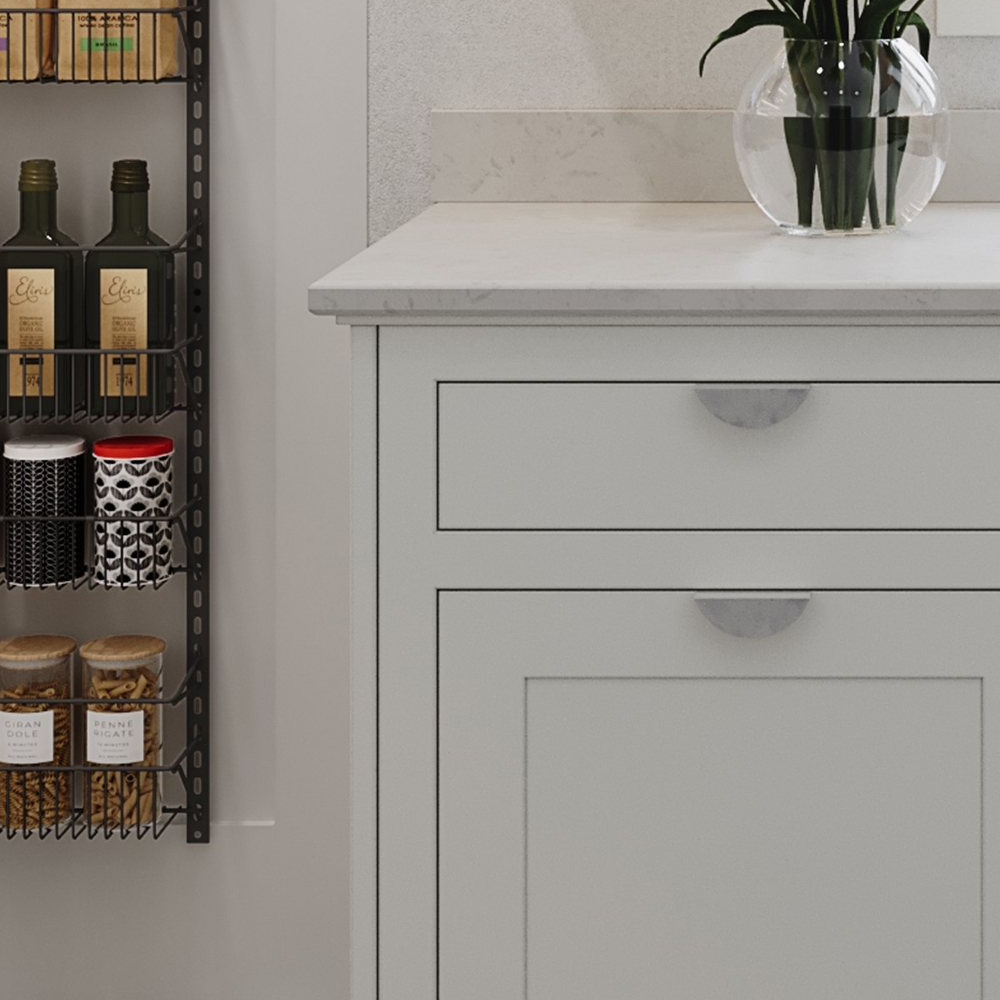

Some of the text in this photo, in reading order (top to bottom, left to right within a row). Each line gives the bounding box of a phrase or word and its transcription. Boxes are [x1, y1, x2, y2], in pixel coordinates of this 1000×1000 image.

[26, 376, 41, 387] 974
[4, 720, 42, 728] GIRAN
[94, 720, 133, 728] PENNE
[7, 730, 39, 738] DOLE
[94, 730, 134, 738] RIGATE
